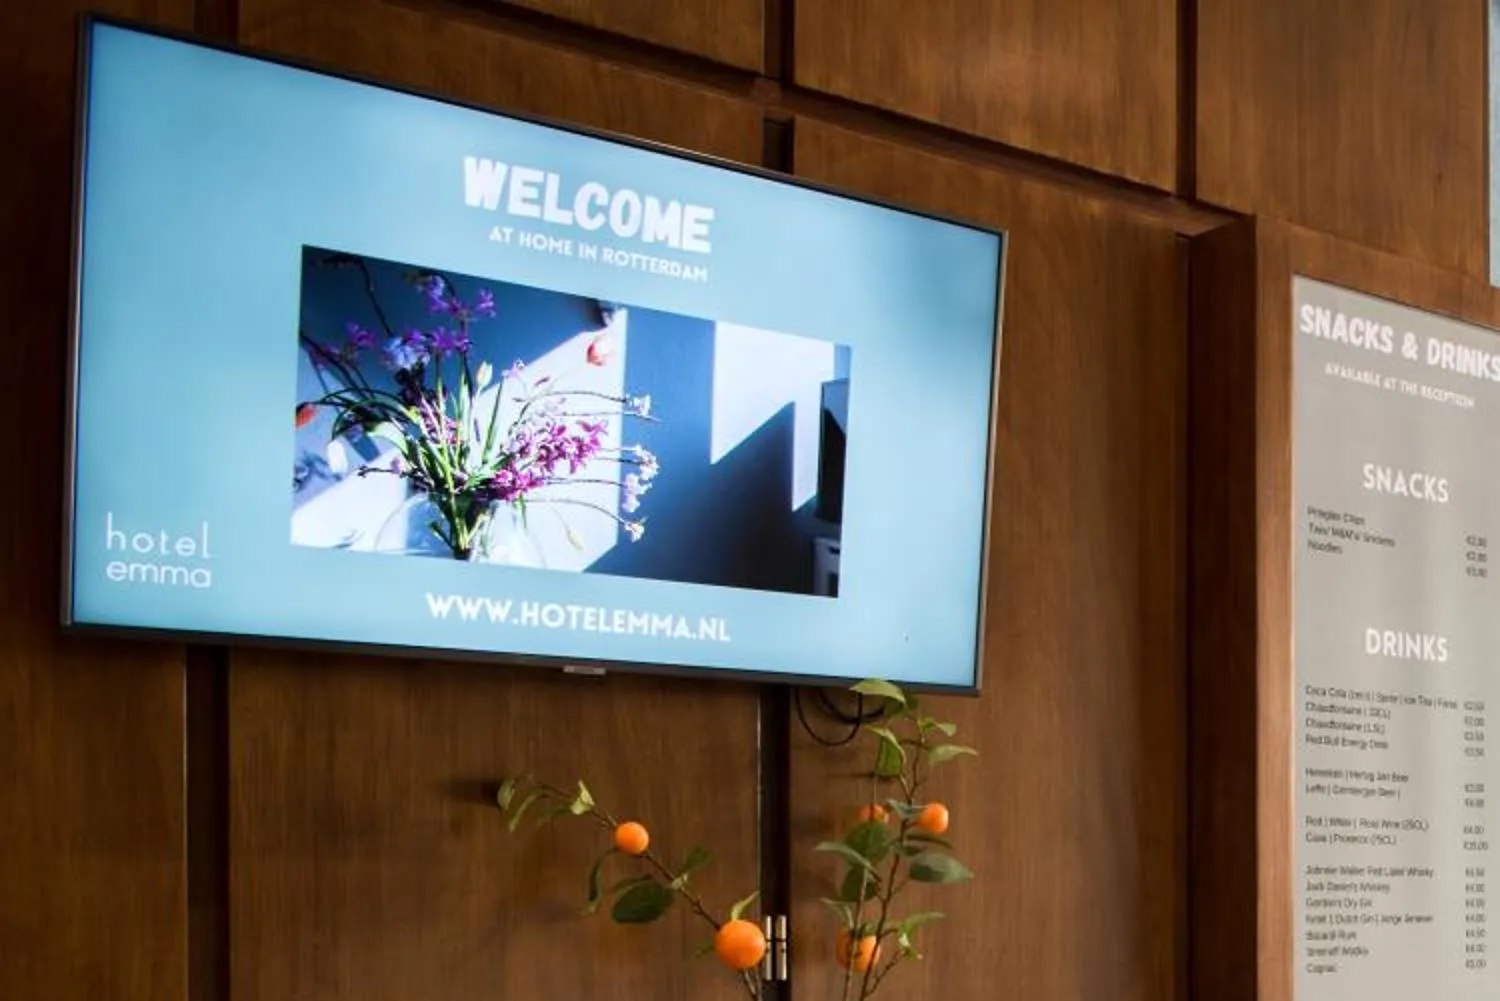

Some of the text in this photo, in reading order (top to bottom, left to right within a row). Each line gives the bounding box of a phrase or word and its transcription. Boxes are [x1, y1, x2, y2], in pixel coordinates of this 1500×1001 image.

[464, 157, 715, 254] WELCOME
[489, 226, 708, 283] AT HOME IN ROTTERDAM
[1300, 304, 1394, 354] SNACKS
[1401, 333, 1419, 361] &
[1325, 362, 1476, 409] AVAILABLE AT THE RECEPTION
[1363, 463, 1449, 503] SNACKS
[107, 512, 209, 559] hotel
[106, 561, 212, 588] emma
[425, 592, 731, 642] WWW.HOTELEMMA.NL
[1365, 628, 1449, 662] DRINKS
